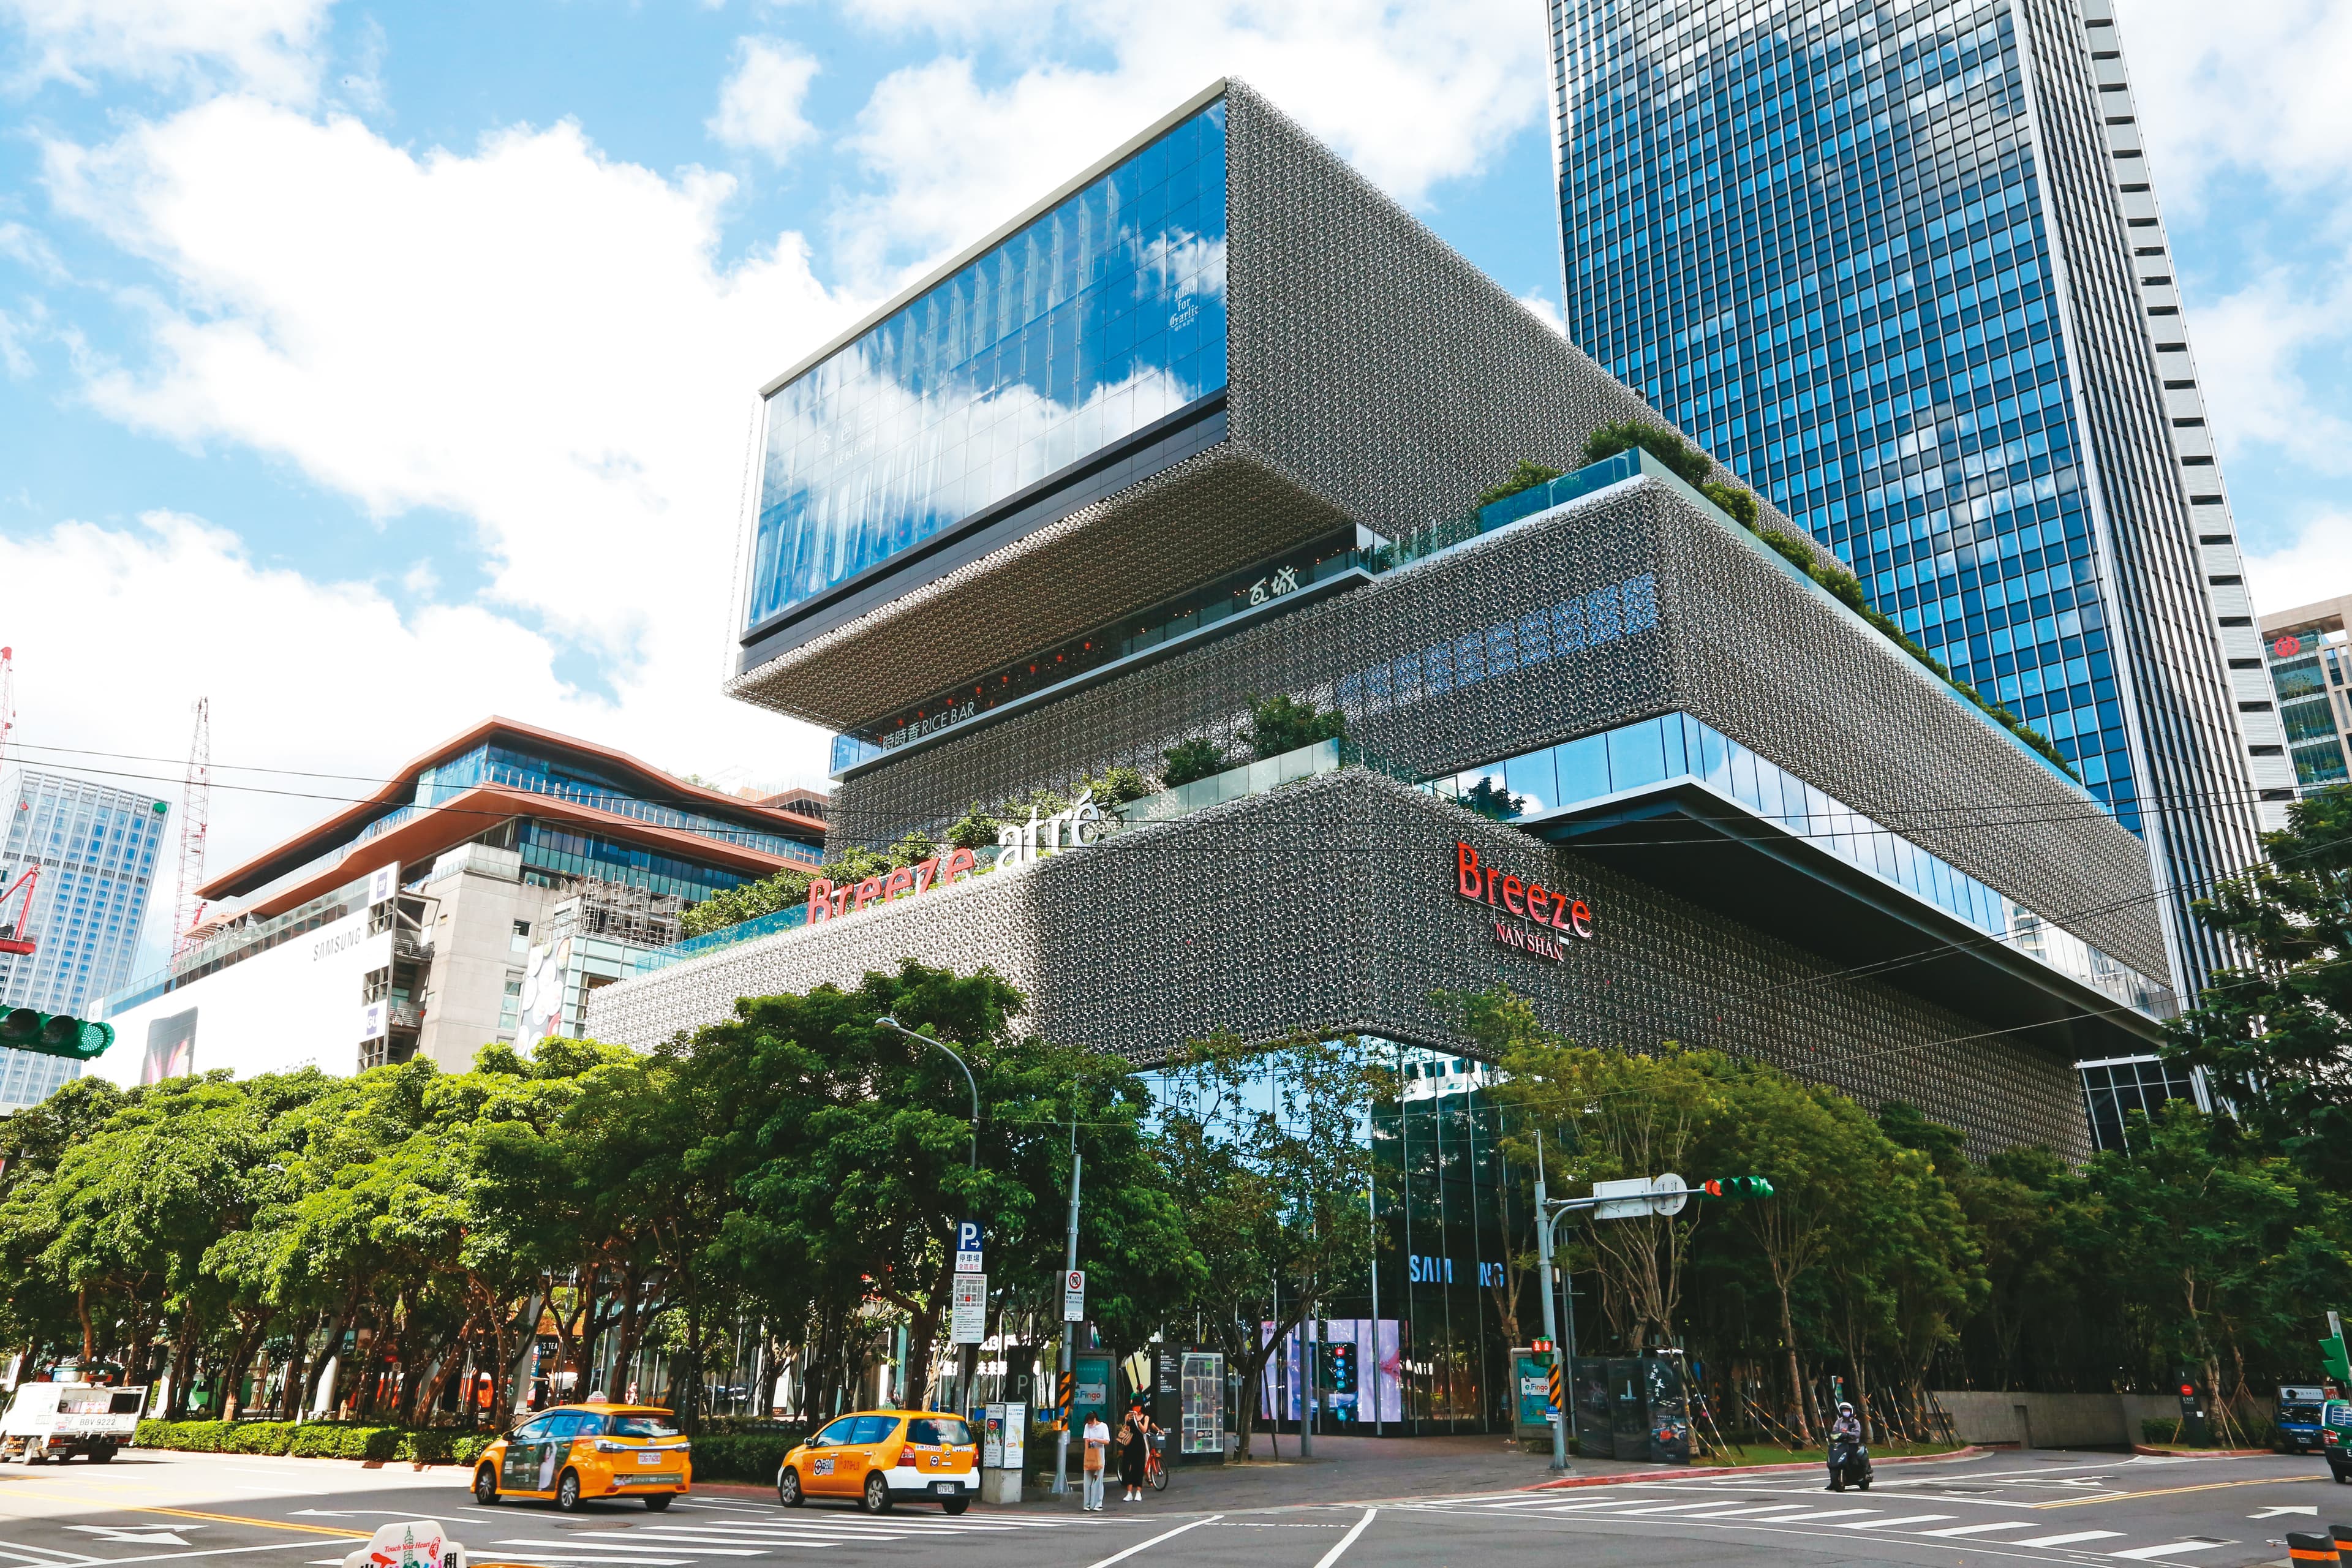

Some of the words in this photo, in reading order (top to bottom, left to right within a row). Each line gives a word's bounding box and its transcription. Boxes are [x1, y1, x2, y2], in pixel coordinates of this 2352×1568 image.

[1170, 304, 1199, 328] Garlic
[1178, 298, 1191, 312] for
[1250, 565, 1299, 606] 瓦城
[883, 722, 920, 751] 時時香
[922, 712, 948, 735] RICE
[951, 701, 974, 724] BAR
[808, 847, 975, 926] Breeze
[996, 788, 1101, 872] atré
[1457, 841, 1593, 938] Breeze
[313, 927, 361, 962] SAMSUNG
[1495, 922, 1526, 949] NAN
[1527, 933, 1564, 962] SHAN
[367, 1014, 378, 1029] GU
[960, 1223, 978, 1250] P
[959, 1254, 979, 1262] 停車場
[1410, 1255, 1504, 1287] SAMNG
[1017, 1374, 1028, 1394] P
